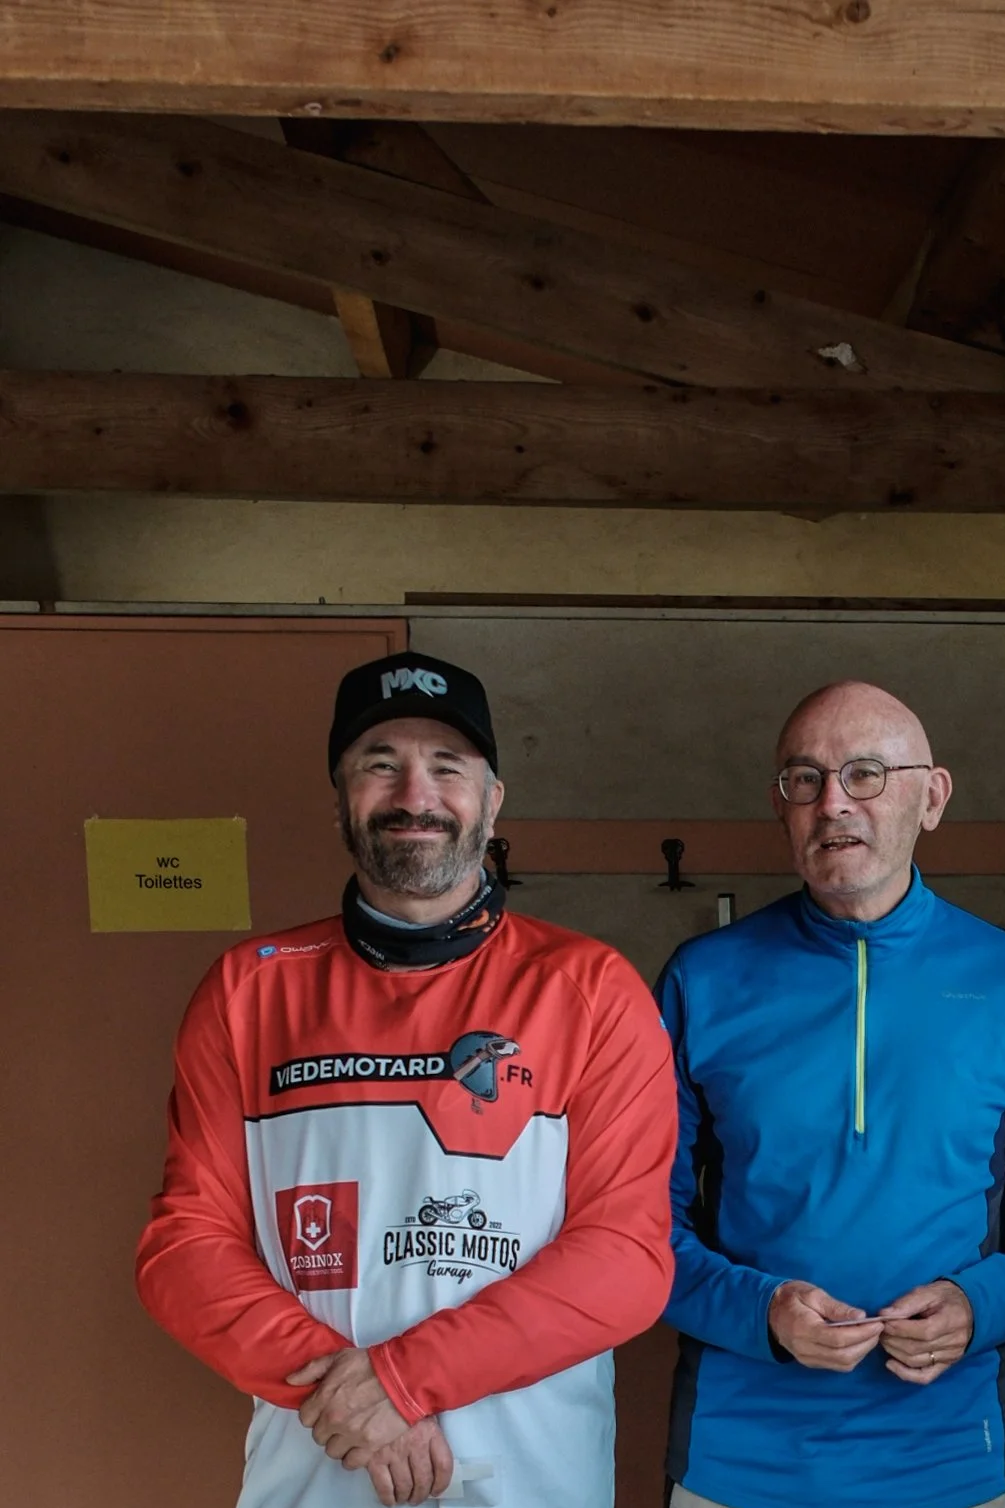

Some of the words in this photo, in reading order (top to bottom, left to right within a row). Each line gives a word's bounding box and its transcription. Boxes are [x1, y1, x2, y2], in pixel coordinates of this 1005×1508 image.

[156, 856, 180, 868] WC
[135, 874, 202, 889] Toilettes
[276, 1056, 445, 1088] VIEDEMOTARD
[500, 1065, 533, 1088] .FR
[290, 1253, 343, 1269] ZOBINOX
[384, 1231, 455, 1265] CLASSIC
[462, 1234, 521, 1273] MOTOS
[427, 1260, 473, 1285] Garage
